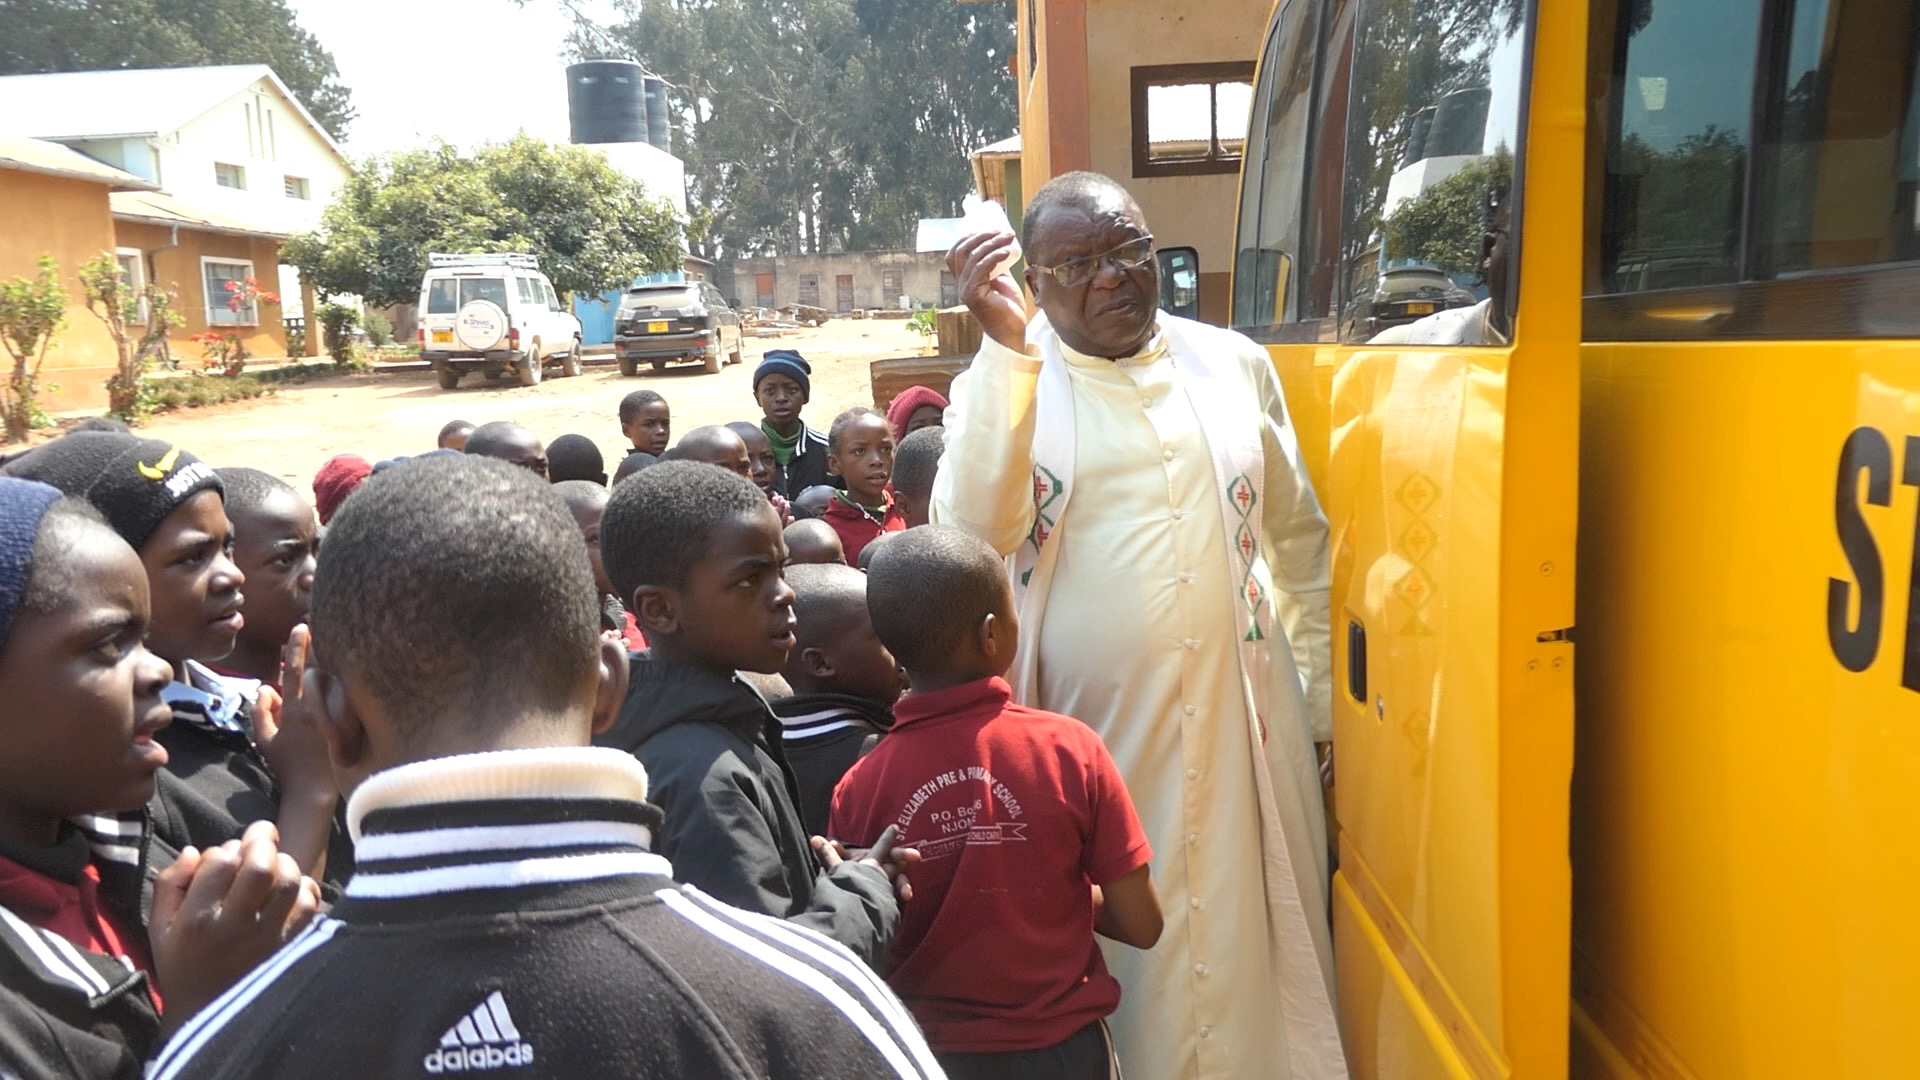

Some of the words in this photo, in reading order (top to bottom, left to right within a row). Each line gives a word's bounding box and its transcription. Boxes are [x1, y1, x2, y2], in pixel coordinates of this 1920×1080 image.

[898, 780, 939, 826] ELIZABETH
[936, 771, 958, 788] PRE
[959, 769, 967, 781] &
[993, 783, 1022, 819] SCHOOL
